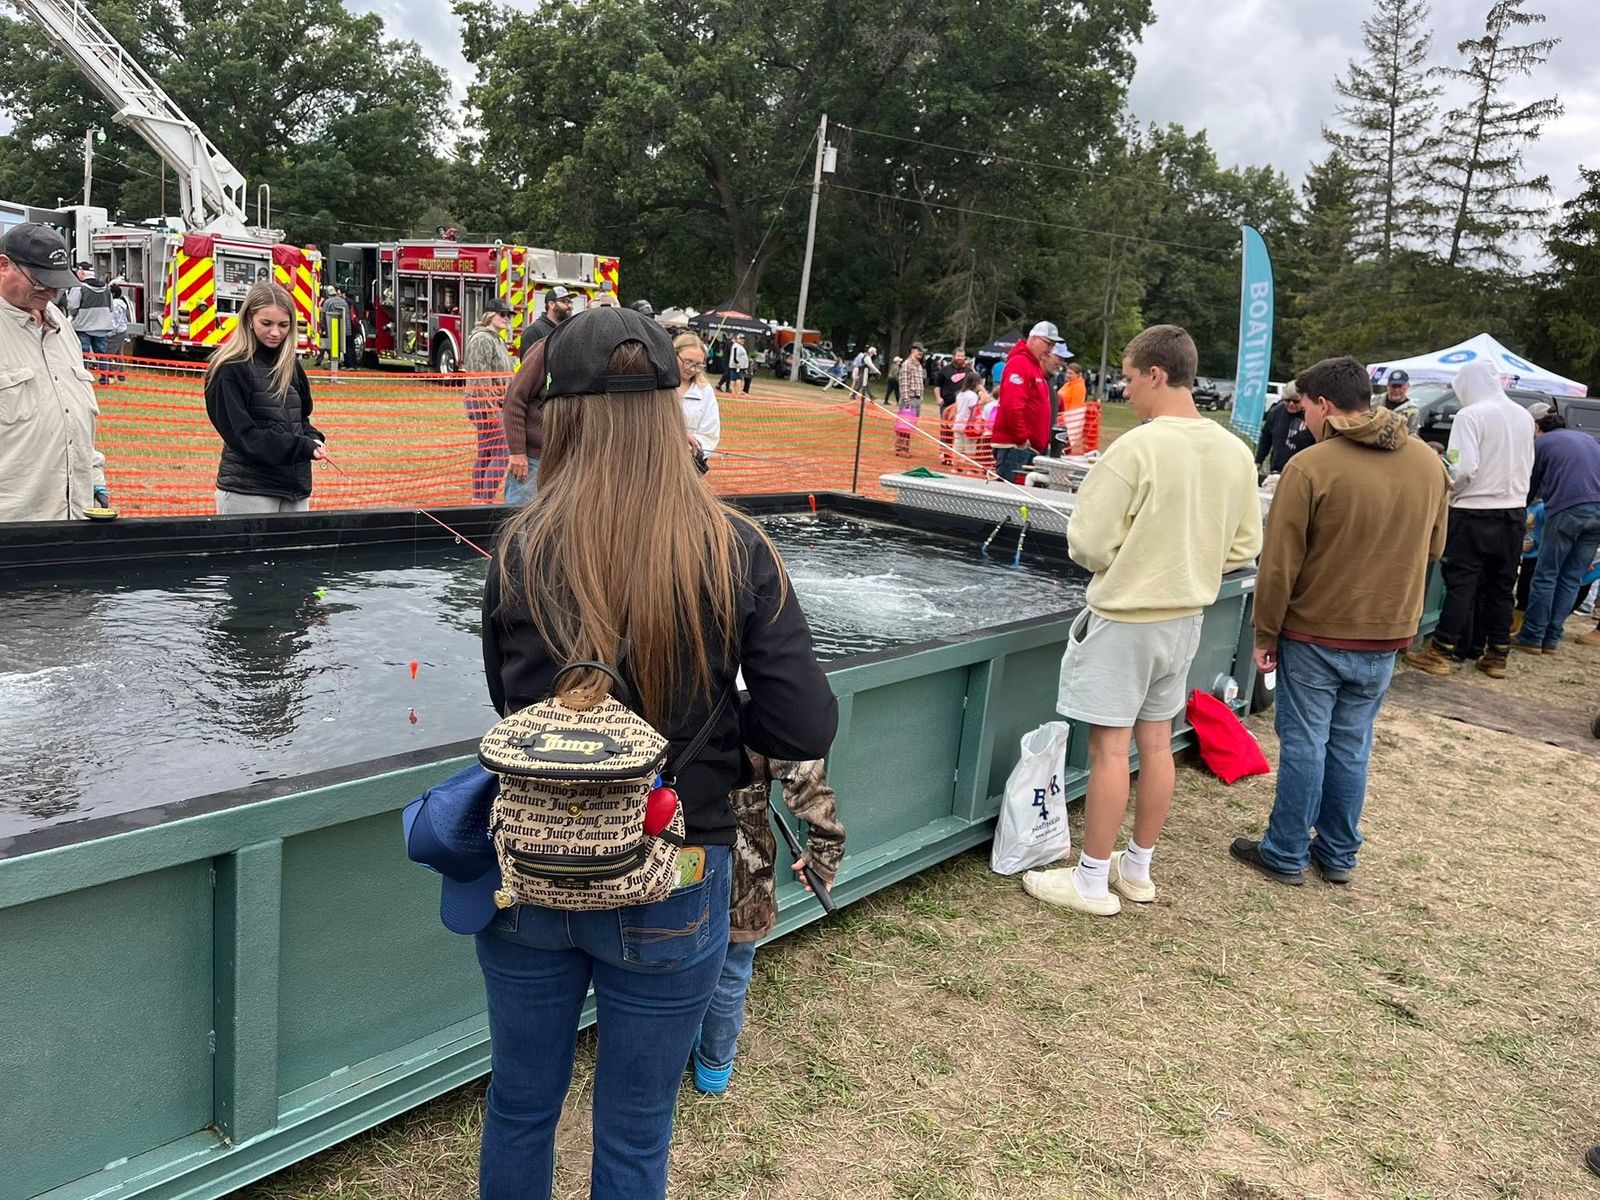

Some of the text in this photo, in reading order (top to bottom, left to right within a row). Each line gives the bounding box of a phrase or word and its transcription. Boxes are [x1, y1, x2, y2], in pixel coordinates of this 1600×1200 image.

[419, 258, 474, 272] FRUITPORT FIRE
[1243, 280, 1270, 397] BOATING
[527, 705, 573, 723] Couture
[573, 713, 605, 726] Juicy
[605, 714, 648, 728] Couture
[488, 726, 519, 738] Juicy
[480, 745, 510, 759] Juicy
[533, 783, 578, 798] Couture
[579, 785, 606, 799] Juicy
[606, 783, 650, 796] Couture
[500, 789, 547, 808] Couture
[547, 797, 572, 811] Jui
[581, 799, 620, 811] Couture
[527, 812, 574, 827] Couture
[575, 815, 603, 828] Juicy
[502, 821, 645, 842] outure Juicy Couture Juic
[522, 841, 569, 855] Couture
[570, 843, 601, 857] Juicy
[529, 887, 575, 899] Couture
[575, 890, 606, 900] Juicy
[548, 897, 580, 906] Juicy
